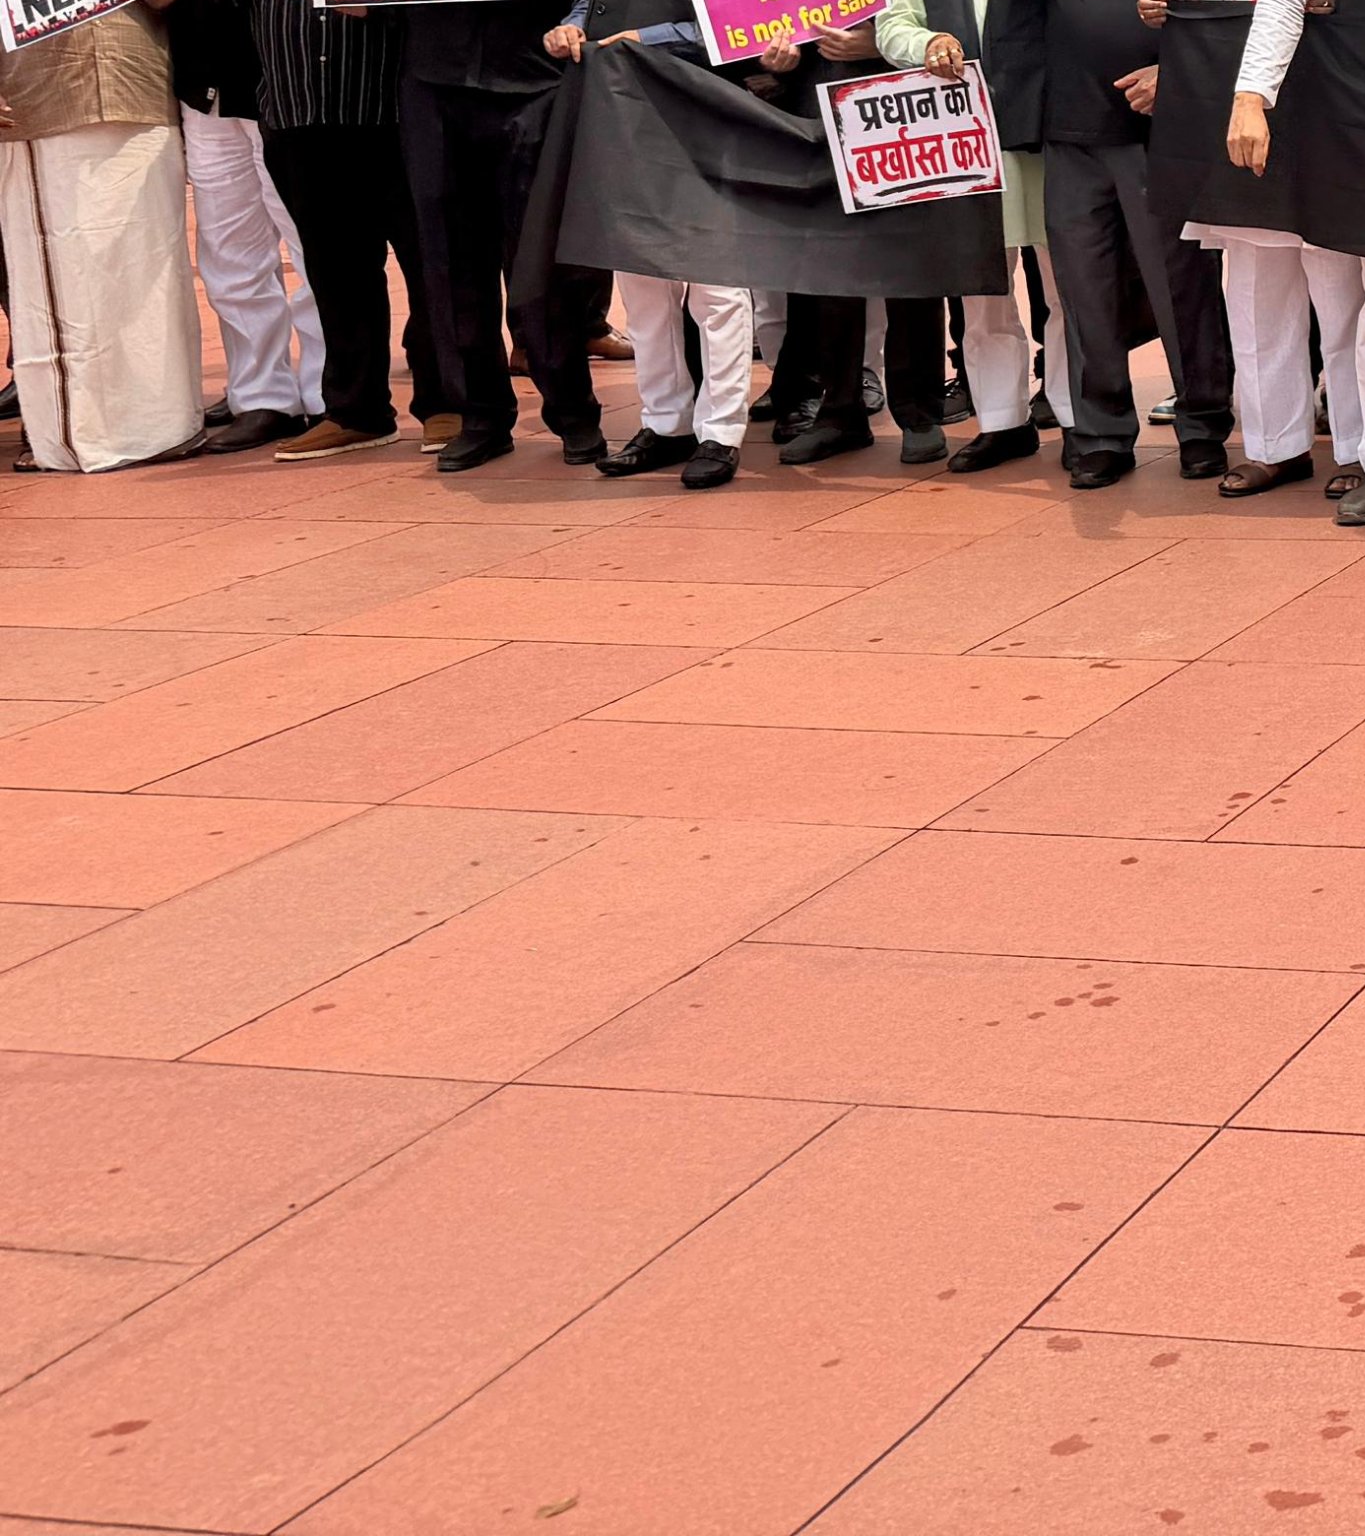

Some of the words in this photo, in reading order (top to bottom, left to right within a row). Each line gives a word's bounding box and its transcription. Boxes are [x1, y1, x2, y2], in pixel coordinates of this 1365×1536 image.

[724, 24, 749, 49] is
[752, 13, 795, 44] not
[798, 2, 833, 31] for
[854, 86, 939, 132] प्रधान
[850, 126, 948, 185] बर्खास्त
[947, 116, 992, 171] करो
